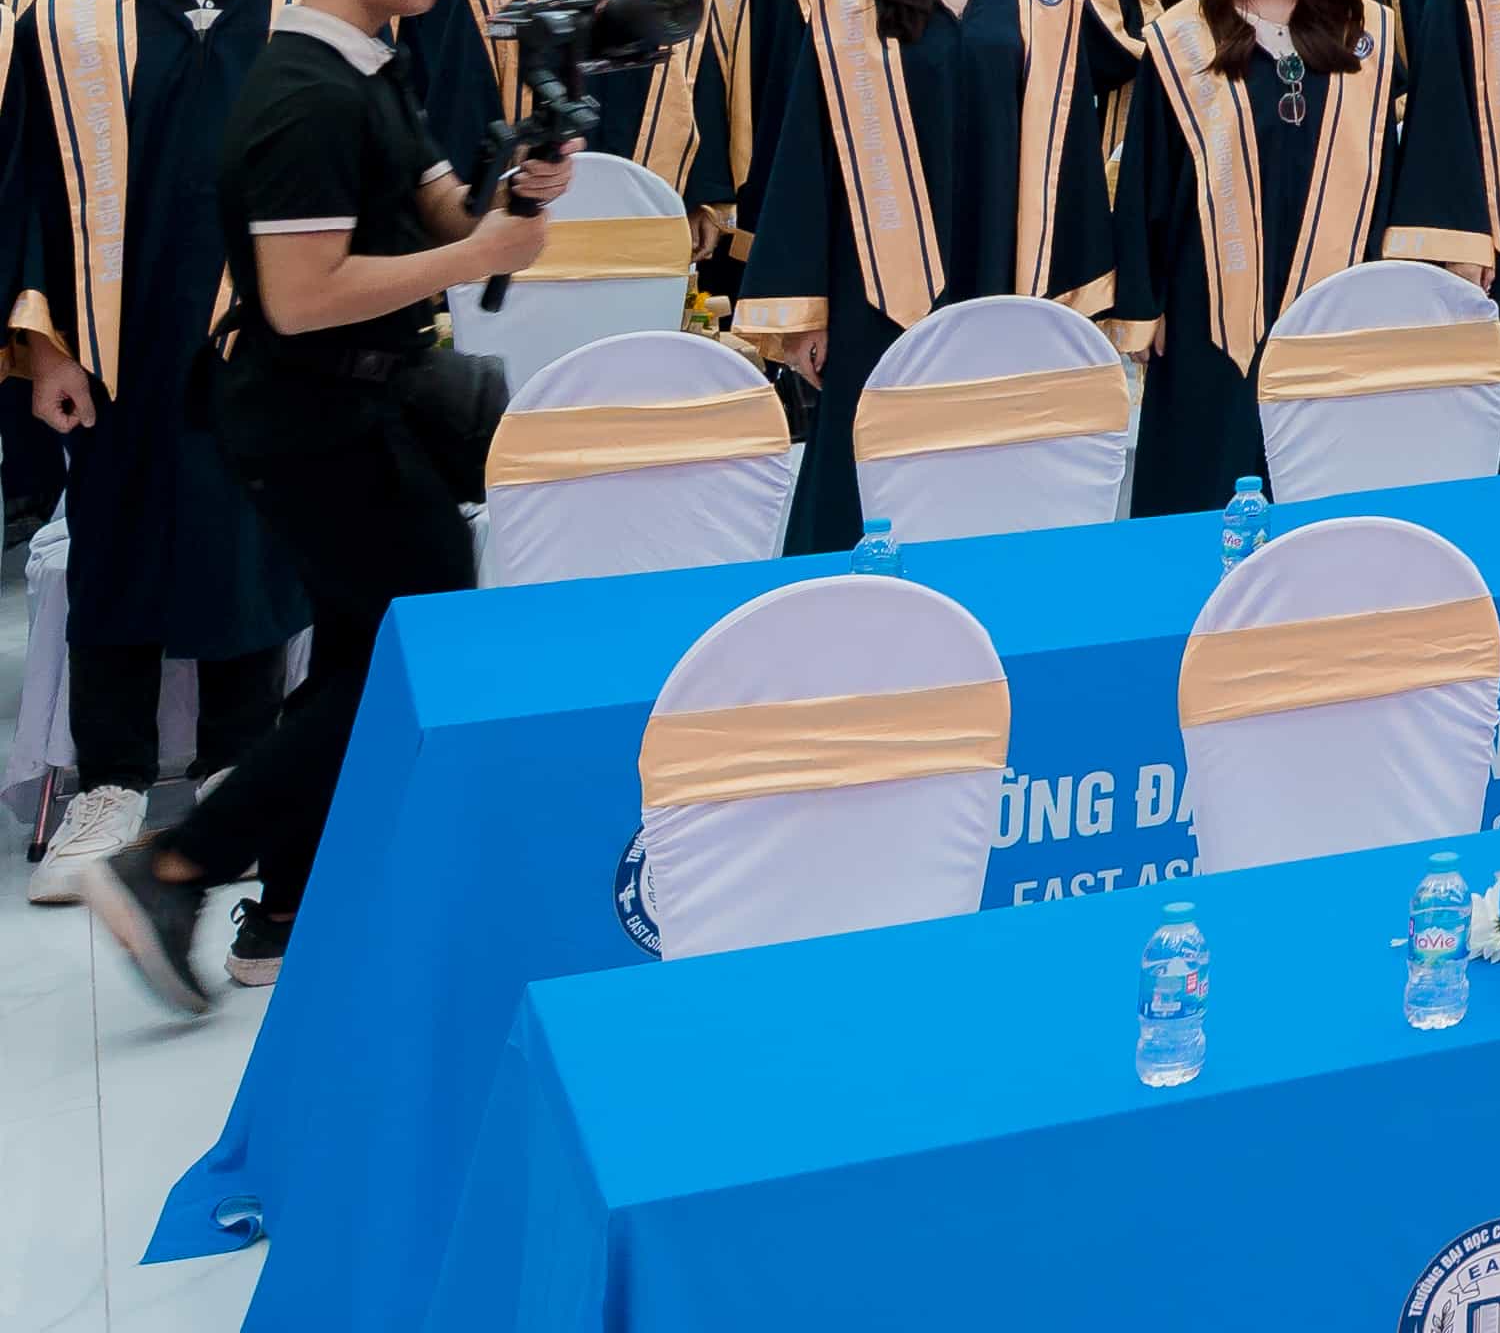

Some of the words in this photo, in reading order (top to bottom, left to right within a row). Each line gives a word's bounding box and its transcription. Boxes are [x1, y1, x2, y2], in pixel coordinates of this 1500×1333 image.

[853, 71, 883, 149] University
[89, 101, 114, 191] University
[1210, 124, 1237, 197] University
[872, 156, 891, 190] Asia
[99, 194, 119, 235] Asia
[877, 195, 901, 230] East
[100, 242, 123, 282] East
[1224, 241, 1247, 273] East
[991, 767, 1115, 848] ỜNG
[626, 914, 649, 939] EAST
[1408, 1268, 1444, 1317] TRƯỜNG
[1441, 1246, 1464, 1269] ĐẠI
[1463, 1229, 1490, 1252] HỌC
